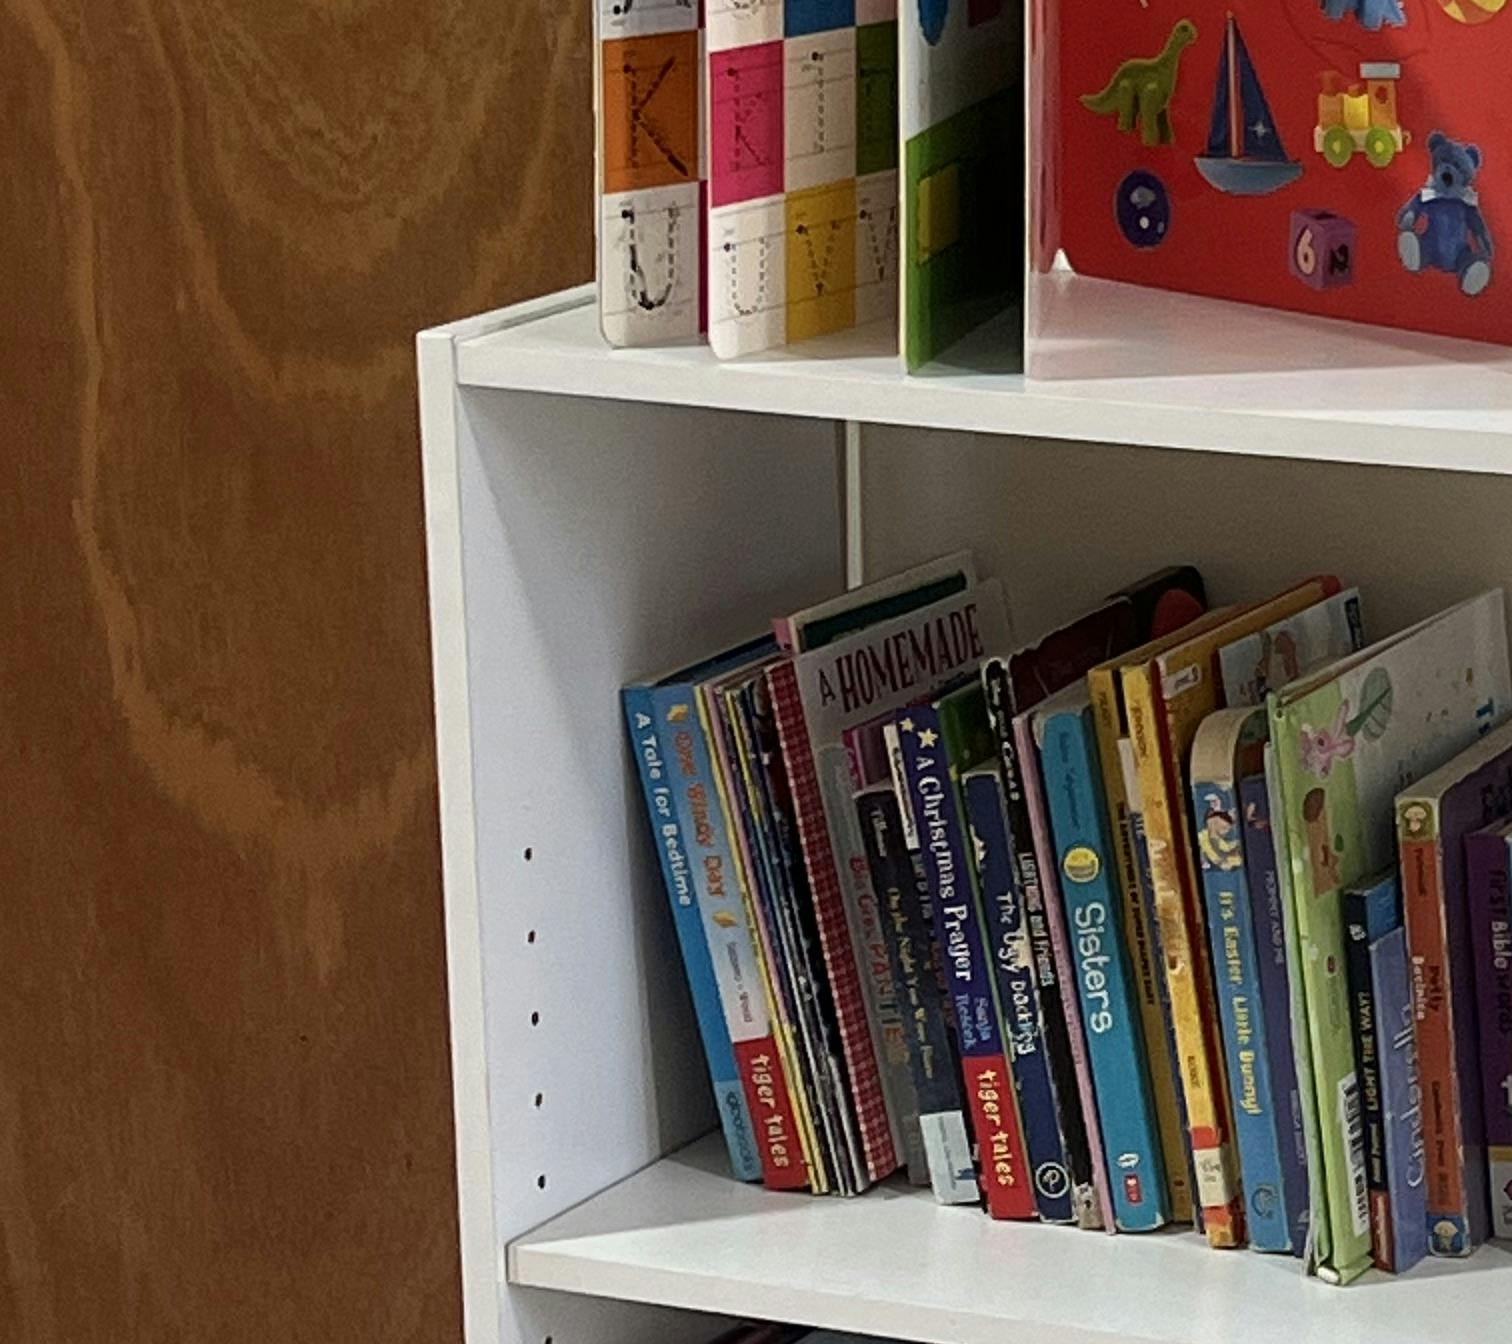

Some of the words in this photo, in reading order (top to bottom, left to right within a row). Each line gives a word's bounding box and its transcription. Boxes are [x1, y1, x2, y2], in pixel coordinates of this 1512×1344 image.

[623, 53, 689, 177] K
[623, 205, 680, 310] U
[725, 238, 769, 316] u
[819, 668, 836, 706] A
[836, 603, 984, 713] HOMEMADE
[635, 711, 652, 730] A
[640, 736, 663, 779] Tale
[915, 755, 935, 771] A
[652, 787, 673, 817] for
[660, 823, 694, 906] Bedtime
[919, 775, 962, 900] Christmas
[995, 891, 1017, 925] The
[942, 903, 972, 982] Prayer
[997, 929, 1031, 974] Ugly
[1073, 901, 1117, 1035] Sisters
[1490, 920, 1510, 969] Bible
[1426, 964, 1444, 1013] Potty
[1231, 995, 1257, 1046] Little
[1359, 1035, 1377, 1063] THE
[974, 1068, 1004, 1128] tiger
[1236, 1049, 1265, 1116] Bunny!
[1361, 1067, 1380, 1112] LIGHT
[750, 1054, 776, 1107] tiger
[765, 1116, 790, 1168] tales
[988, 1131, 1017, 1187] tales
